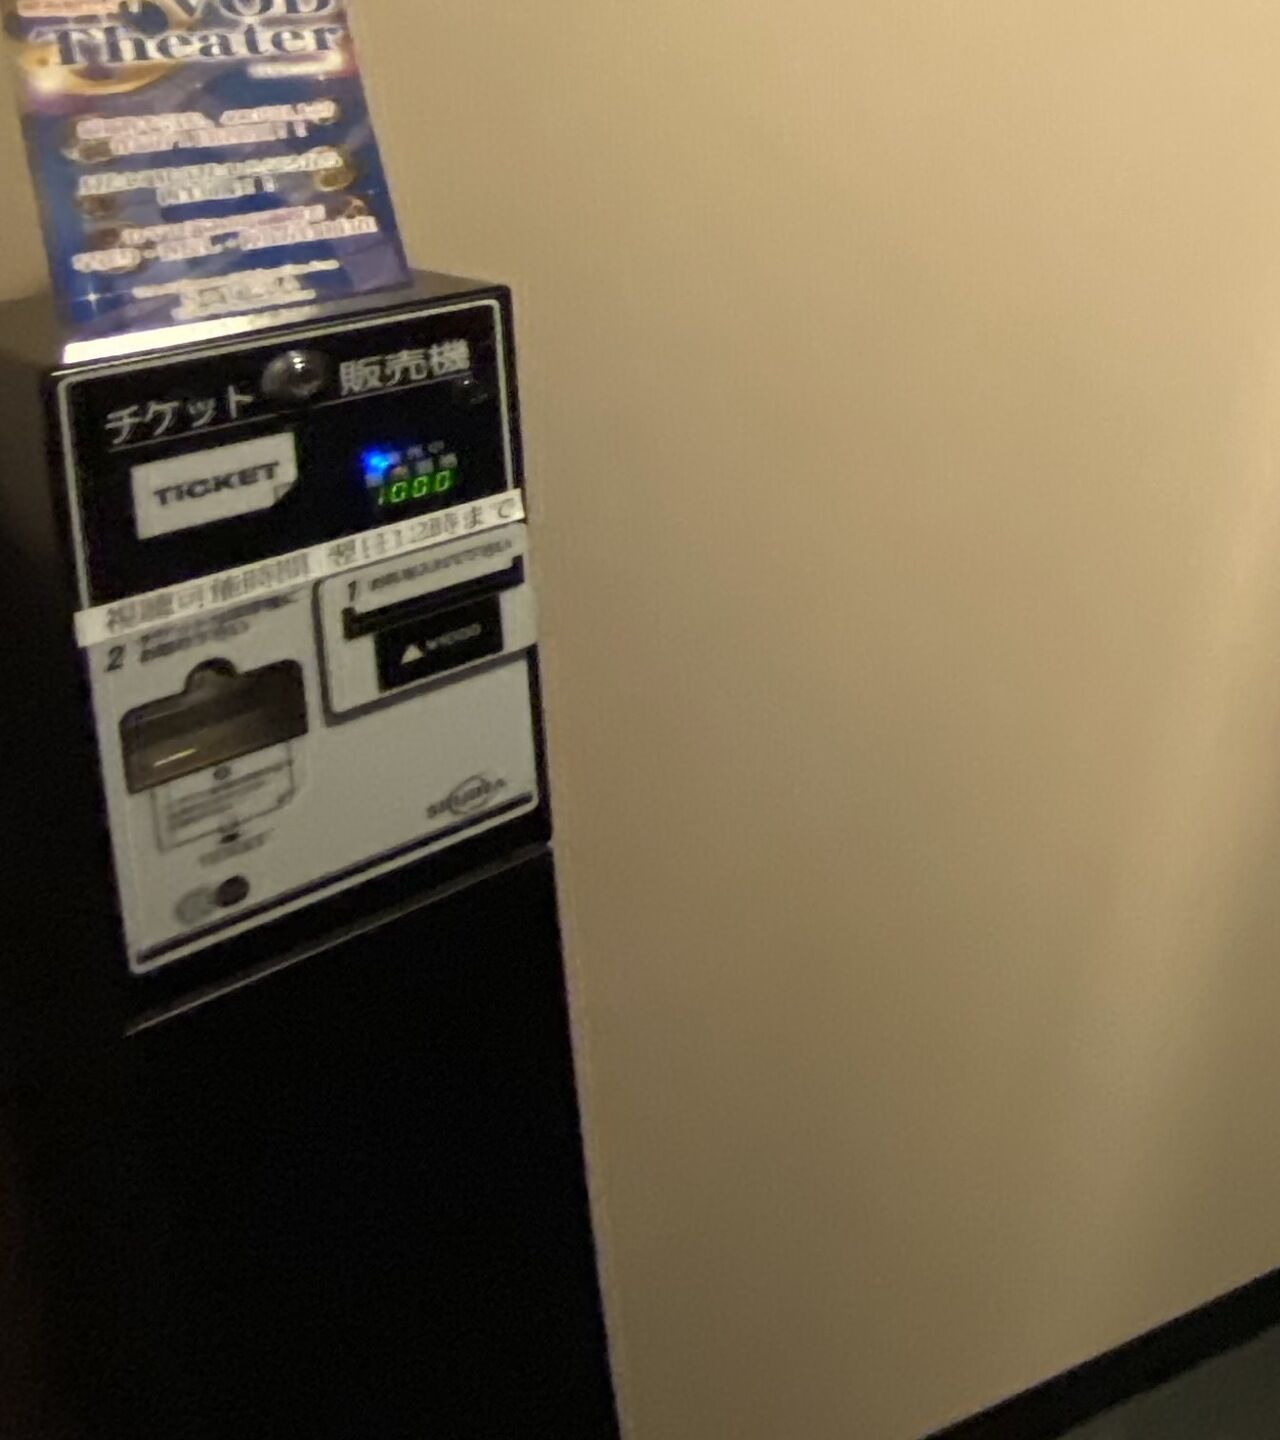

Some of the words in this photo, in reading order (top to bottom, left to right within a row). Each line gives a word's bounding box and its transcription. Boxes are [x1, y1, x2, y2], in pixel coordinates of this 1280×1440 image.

[30, 22, 346, 68] Theater
[105, 383, 256, 446] チケット
[338, 337, 472, 396] 販売機
[153, 461, 282, 508] TICKET
[376, 469, 451, 506] 1000
